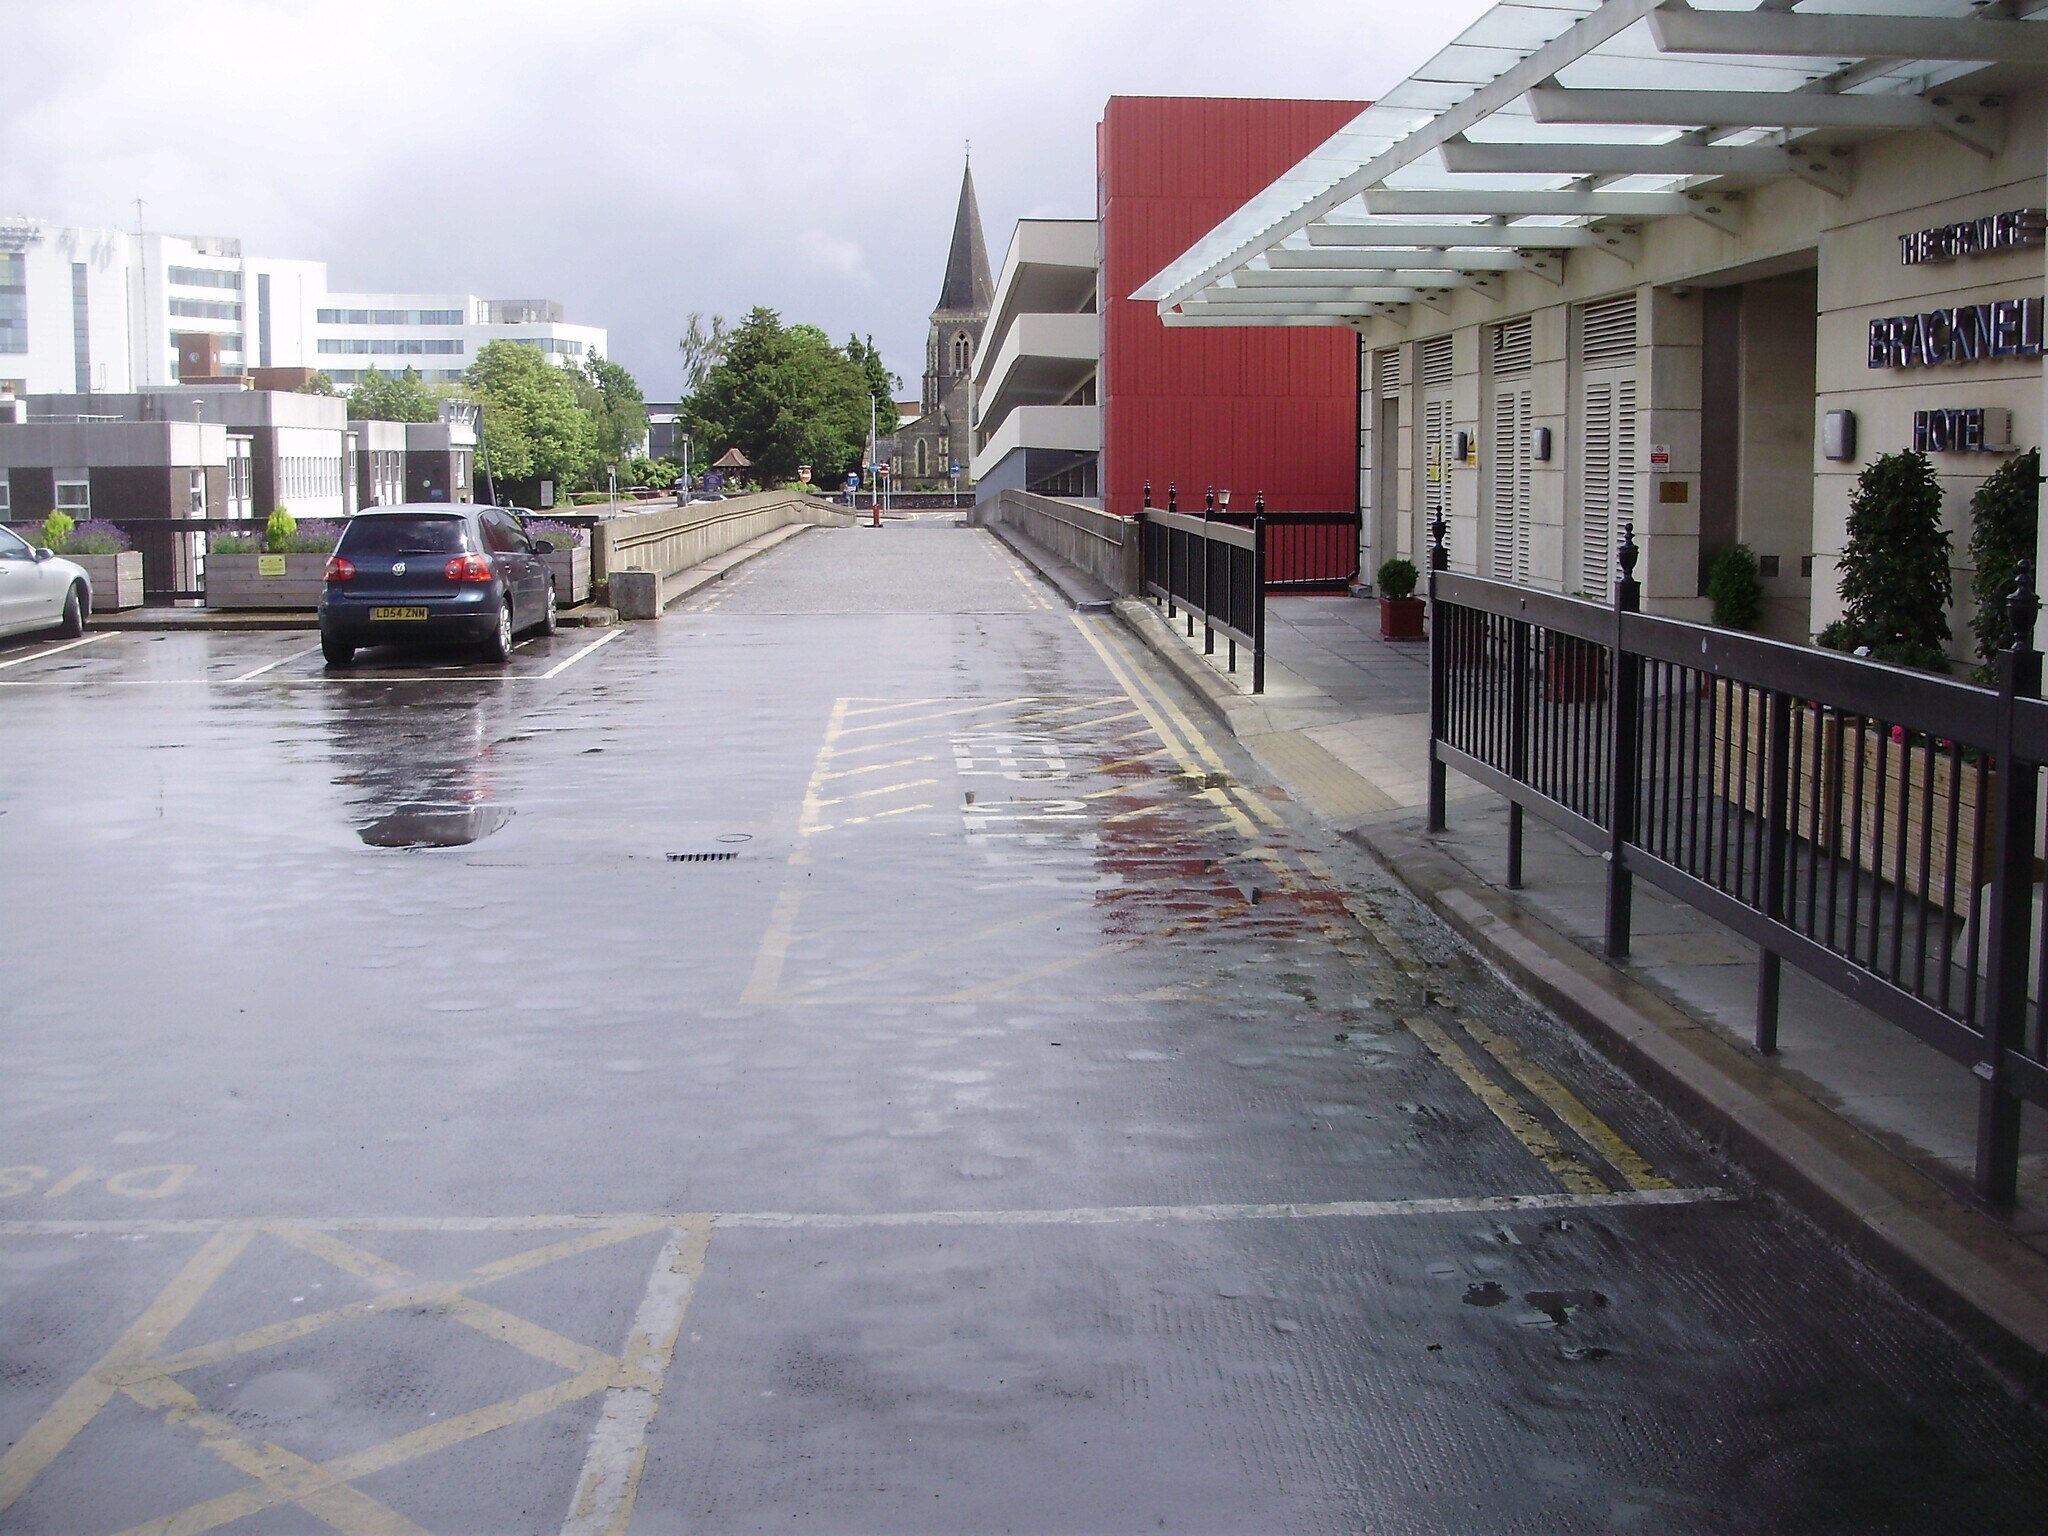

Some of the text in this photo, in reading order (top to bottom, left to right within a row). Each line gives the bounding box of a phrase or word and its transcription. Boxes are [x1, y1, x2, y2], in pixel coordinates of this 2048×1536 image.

[1898, 208, 2030, 265] THE GRANGE
[1913, 408, 2018, 453] HOTEL
[376, 608, 403, 618] LD54
[948, 731, 1124, 890] KEEP CLEAR
